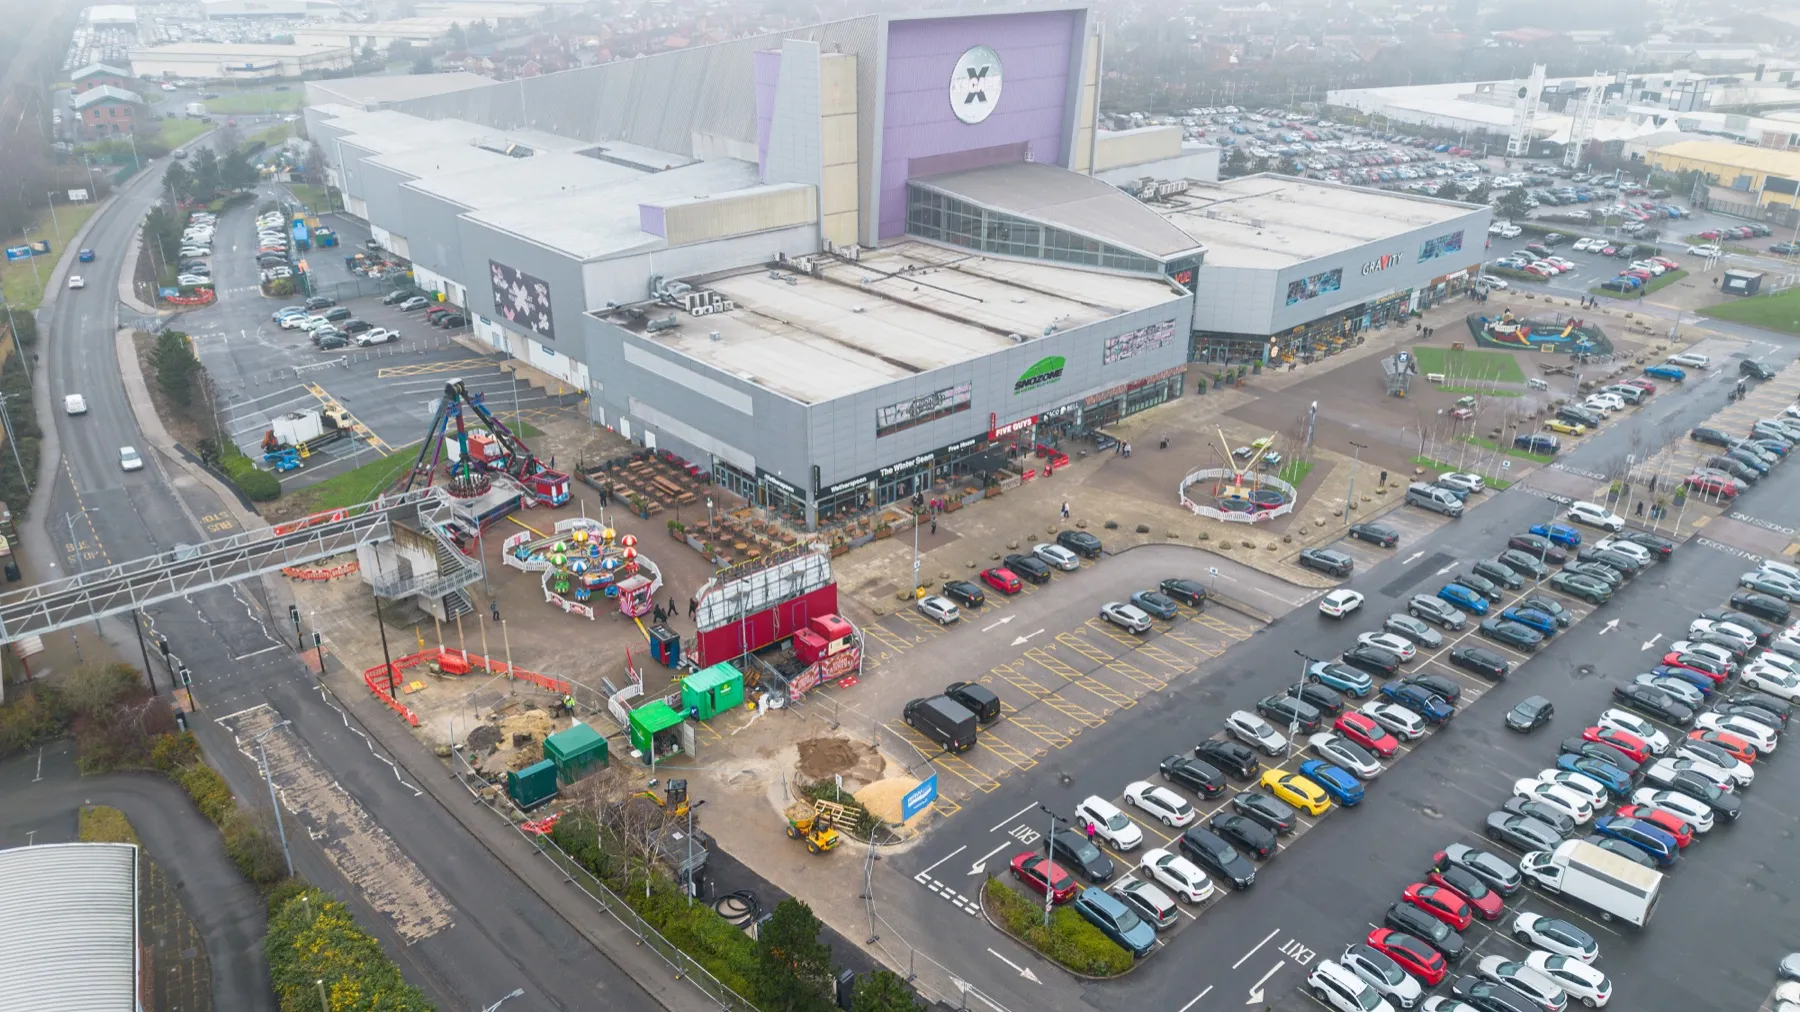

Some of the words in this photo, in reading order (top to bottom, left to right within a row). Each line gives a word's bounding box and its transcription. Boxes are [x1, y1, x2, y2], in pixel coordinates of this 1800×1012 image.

[1362, 252, 1403, 276] GRAVITY
[1014, 368, 1063, 390] SNOZONE
[1066, 402, 1079, 412] BELL
[995, 423, 1012, 437] FIVE
[1012, 418, 1032, 431] GUYS
[948, 444, 959, 452] Free
[959, 439, 975, 449] House
[880, 467, 893, 477] The
[893, 459, 915, 472] Winter
[915, 452, 934, 464] Seam
[830, 476, 867, 493] Wetherspoon
[207, 520, 233, 533] BUS
[1730, 511, 1795, 535] CROSSING
[1697, 537, 1763, 563] CROSSING
[1008, 824, 1041, 845] EXIT
[1278, 939, 1316, 966] EXIT
